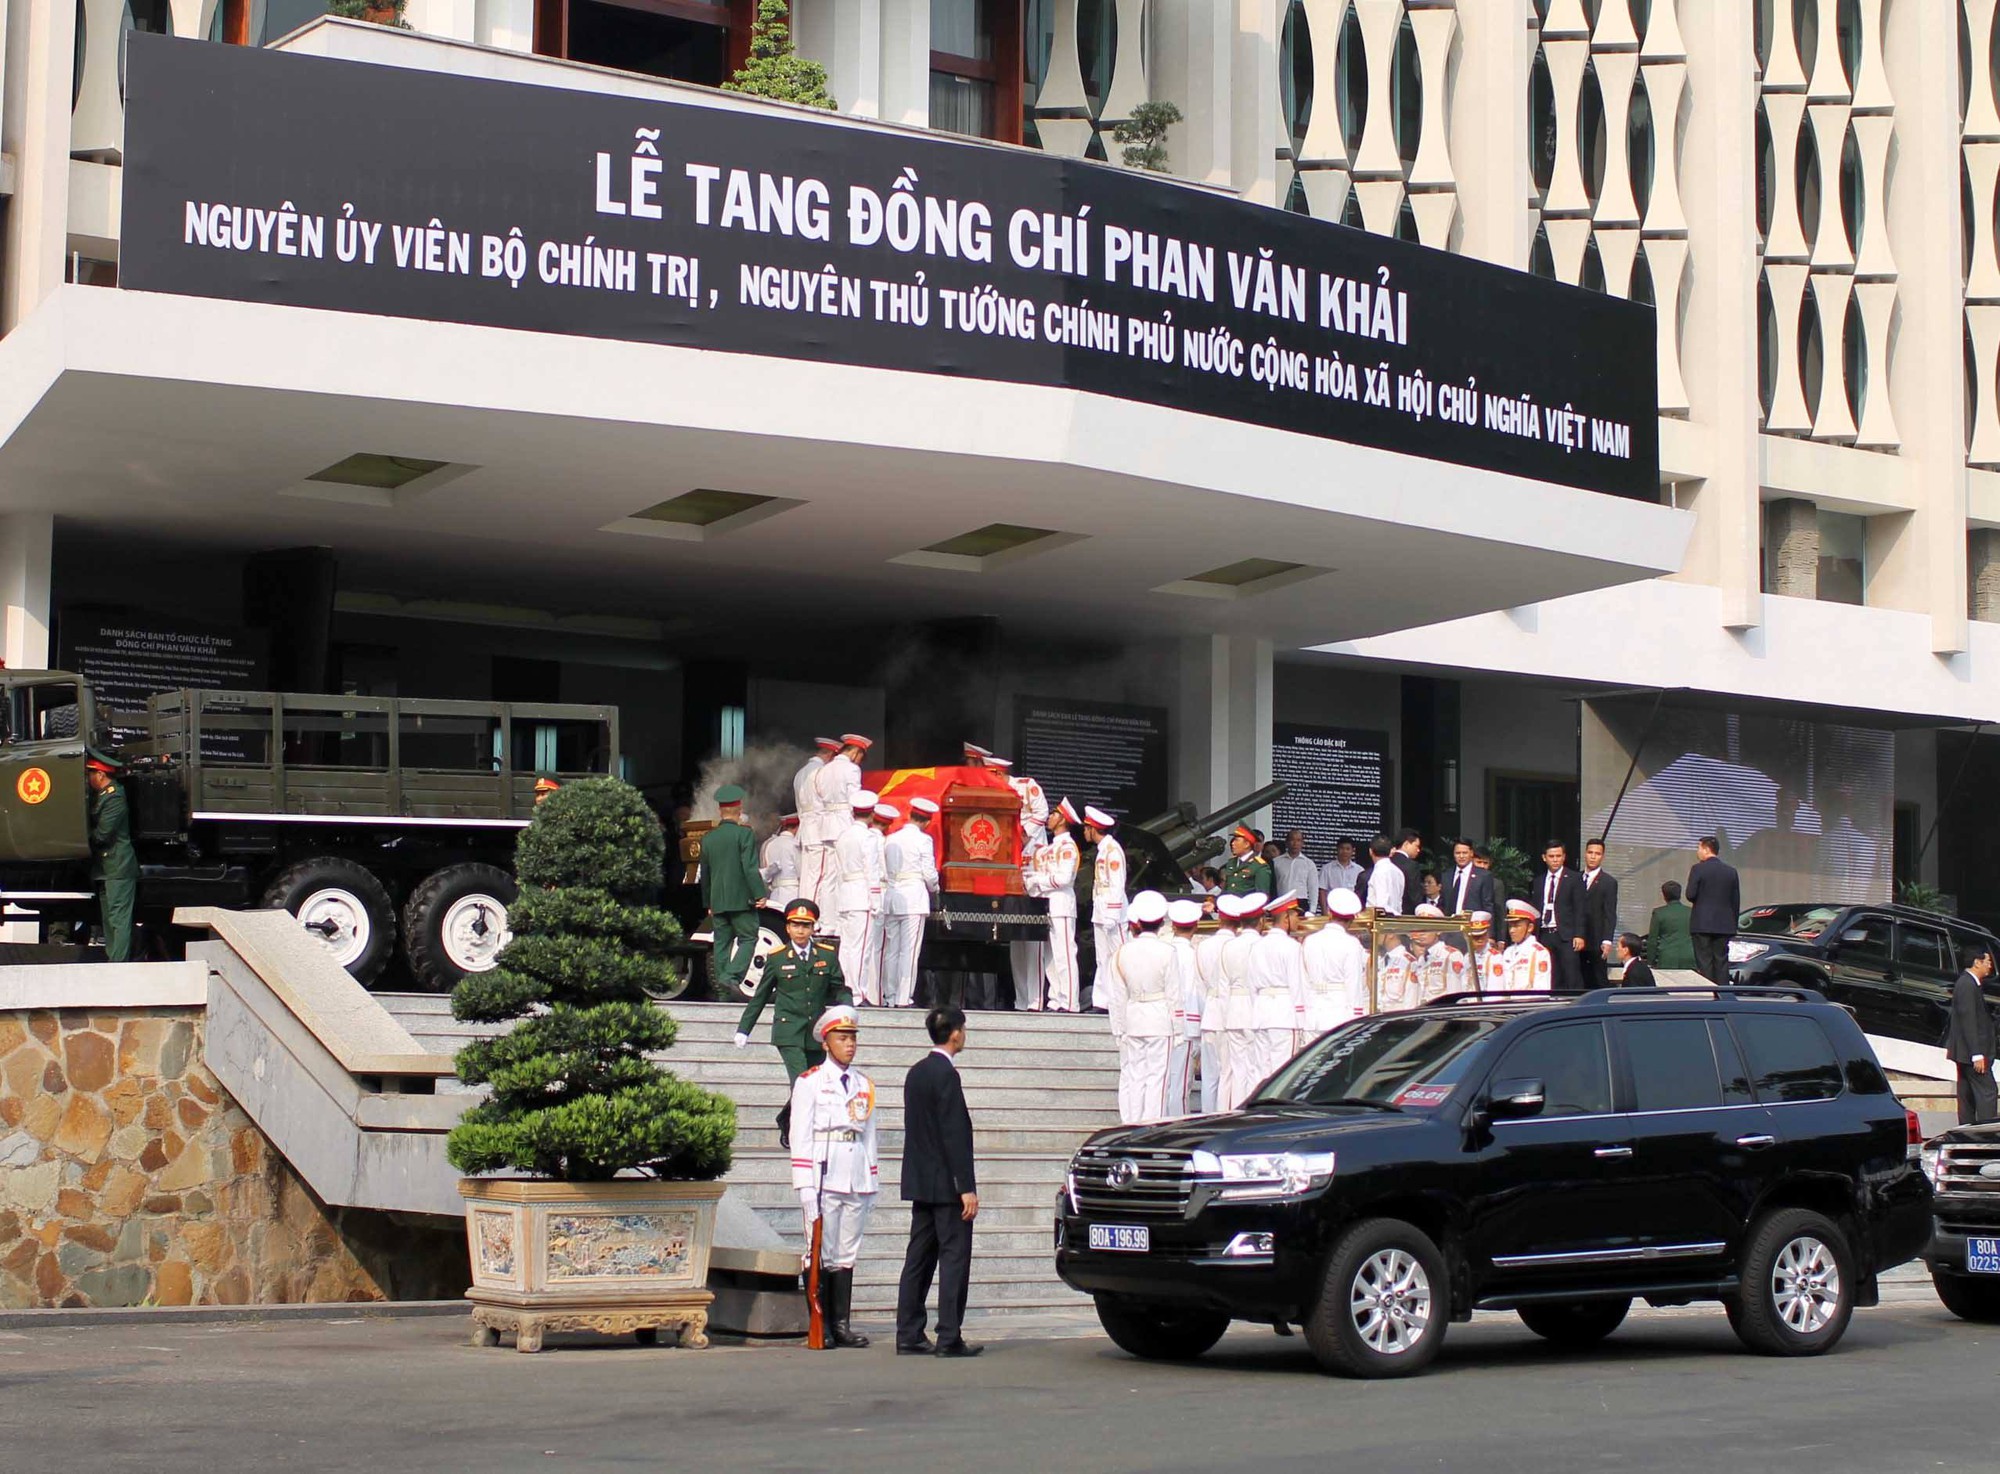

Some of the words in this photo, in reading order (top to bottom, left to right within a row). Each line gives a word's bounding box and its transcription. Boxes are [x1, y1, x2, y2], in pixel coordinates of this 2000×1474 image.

[595, 127, 663, 220] LỄ
[685, 162, 830, 242] TANG
[846, 166, 992, 263] ĐỒNG
[1008, 204, 1091, 277] CHÍ
[1104, 224, 1214, 303] PHAN
[1227, 246, 1306, 323] VĂN
[1320, 265, 1407, 346] KHẢI
[184, 200, 324, 259] NGUYÊN
[335, 202, 383, 264] ỦY
[391, 217, 470, 275] VIÊN
[481, 226, 527, 289] BỘ
[538, 235, 636, 292] CHÍNH
[740, 263, 861, 318] NGUYÊN
[869, 270, 929, 327] THỦ
[939, 284, 1036, 340] TƯỚNG
[1043, 298, 1120, 353] CHÍNH
[1128, 310, 1175, 364] PHỦ
[1183, 326, 1244, 377] NƯỚC
[1250, 336, 1309, 392] CỘNG
[1315, 350, 1358, 402] HÒA
[1363, 361, 1391, 408] XÃ
[1398, 368, 1433, 422] HỘI
[1438, 376, 1478, 426] CHỦ
[1484, 393, 1541, 440] NGHĨA
[1545, 402, 1586, 454] VIỆT
[1591, 417, 1630, 459] NAM
[100, 628, 124, 637] DANH
[1091, 1226, 1148, 1249] 80A-196.99
[1976, 1239, 1998, 1255] 80A
[1970, 1255, 2000, 1271] 022.5
